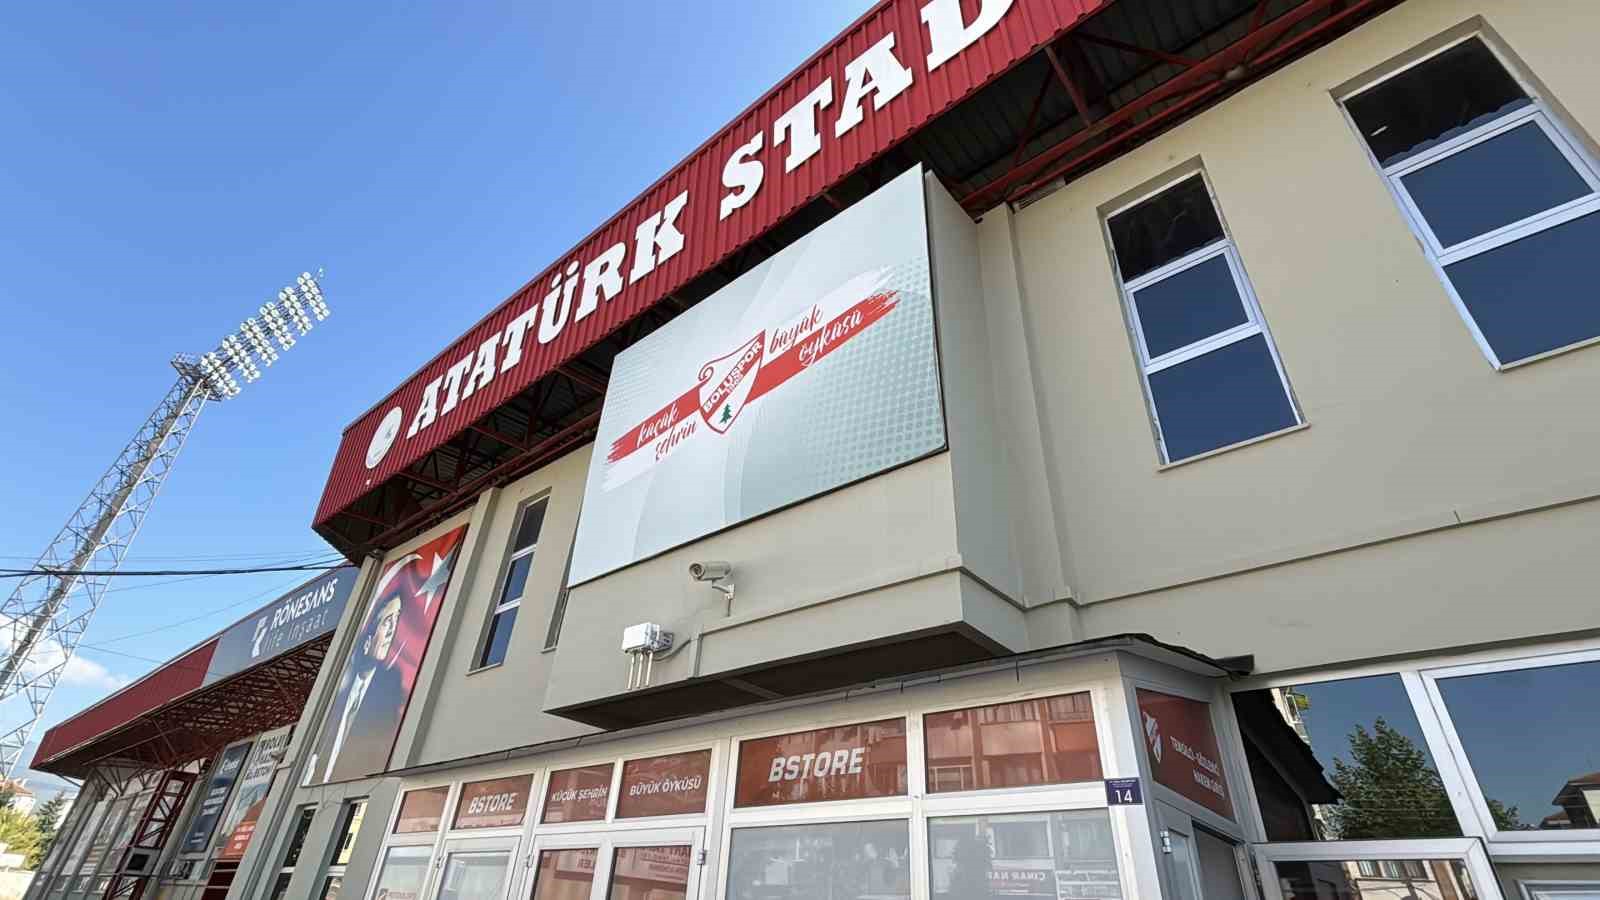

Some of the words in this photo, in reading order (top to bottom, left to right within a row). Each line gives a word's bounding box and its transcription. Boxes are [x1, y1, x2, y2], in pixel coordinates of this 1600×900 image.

[406, 190, 688, 439] ATATÜRK
[702, 340, 763, 413] BOLUSPOR
[270, 577, 339, 631] RÖNESANS
[768, 746, 866, 783] BSTORE
[467, 791, 519, 815] BSTORE
[629, 779, 662, 797] BÜYÜK
[662, 774, 703, 795] ÖYKÜSÜ
[1115, 789, 1133, 803] 14
